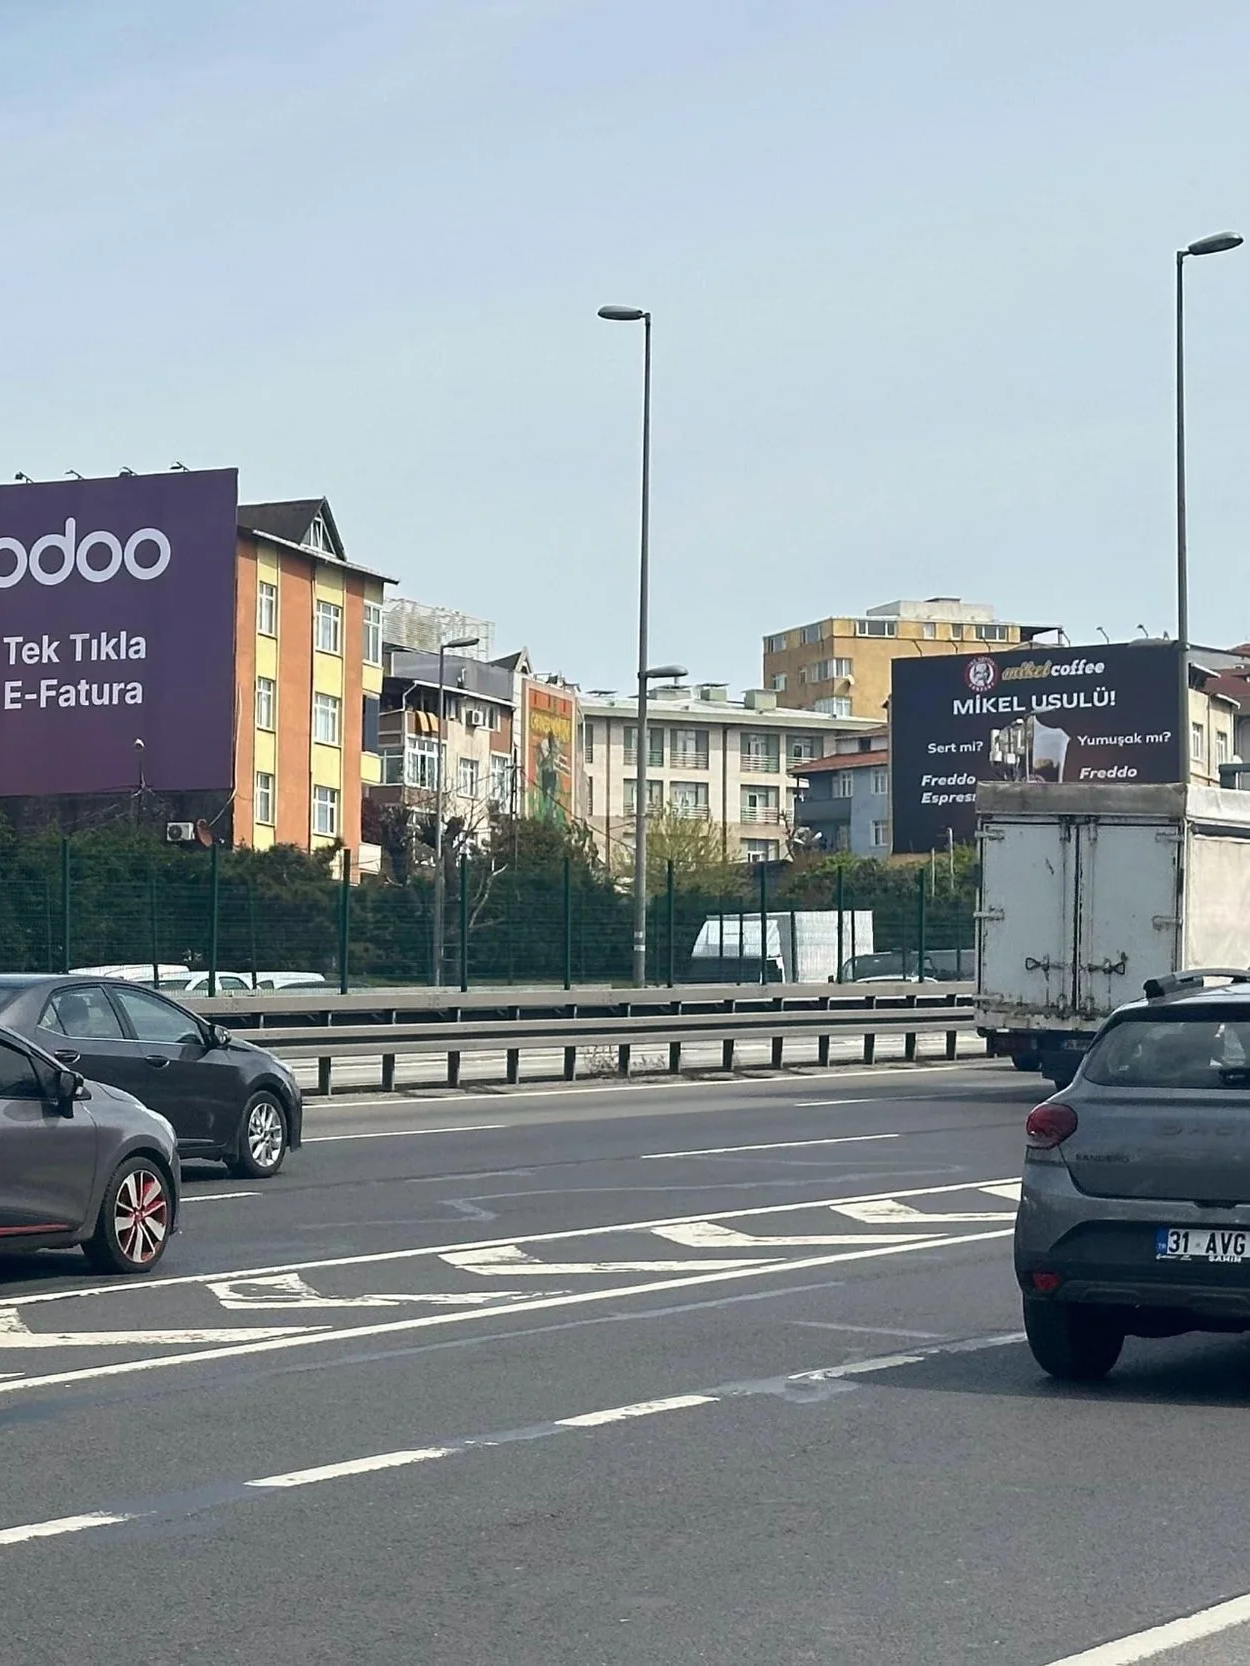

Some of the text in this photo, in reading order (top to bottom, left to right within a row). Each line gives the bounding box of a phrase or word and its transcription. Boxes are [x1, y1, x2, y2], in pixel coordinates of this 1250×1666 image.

[3, 630, 147, 665] Tek Tıkla
[3, 678, 143, 710] E-Fatura
[953, 686, 1116, 715] MİKEL USULÜ!
[927, 741, 983, 753] Sert mi?
[1077, 731, 1172, 747] Yumuşak mı?
[921, 773, 976, 786] Freddo
[1079, 765, 1137, 779] Freddo
[1169, 1231, 1246, 1255] 31 AVG
